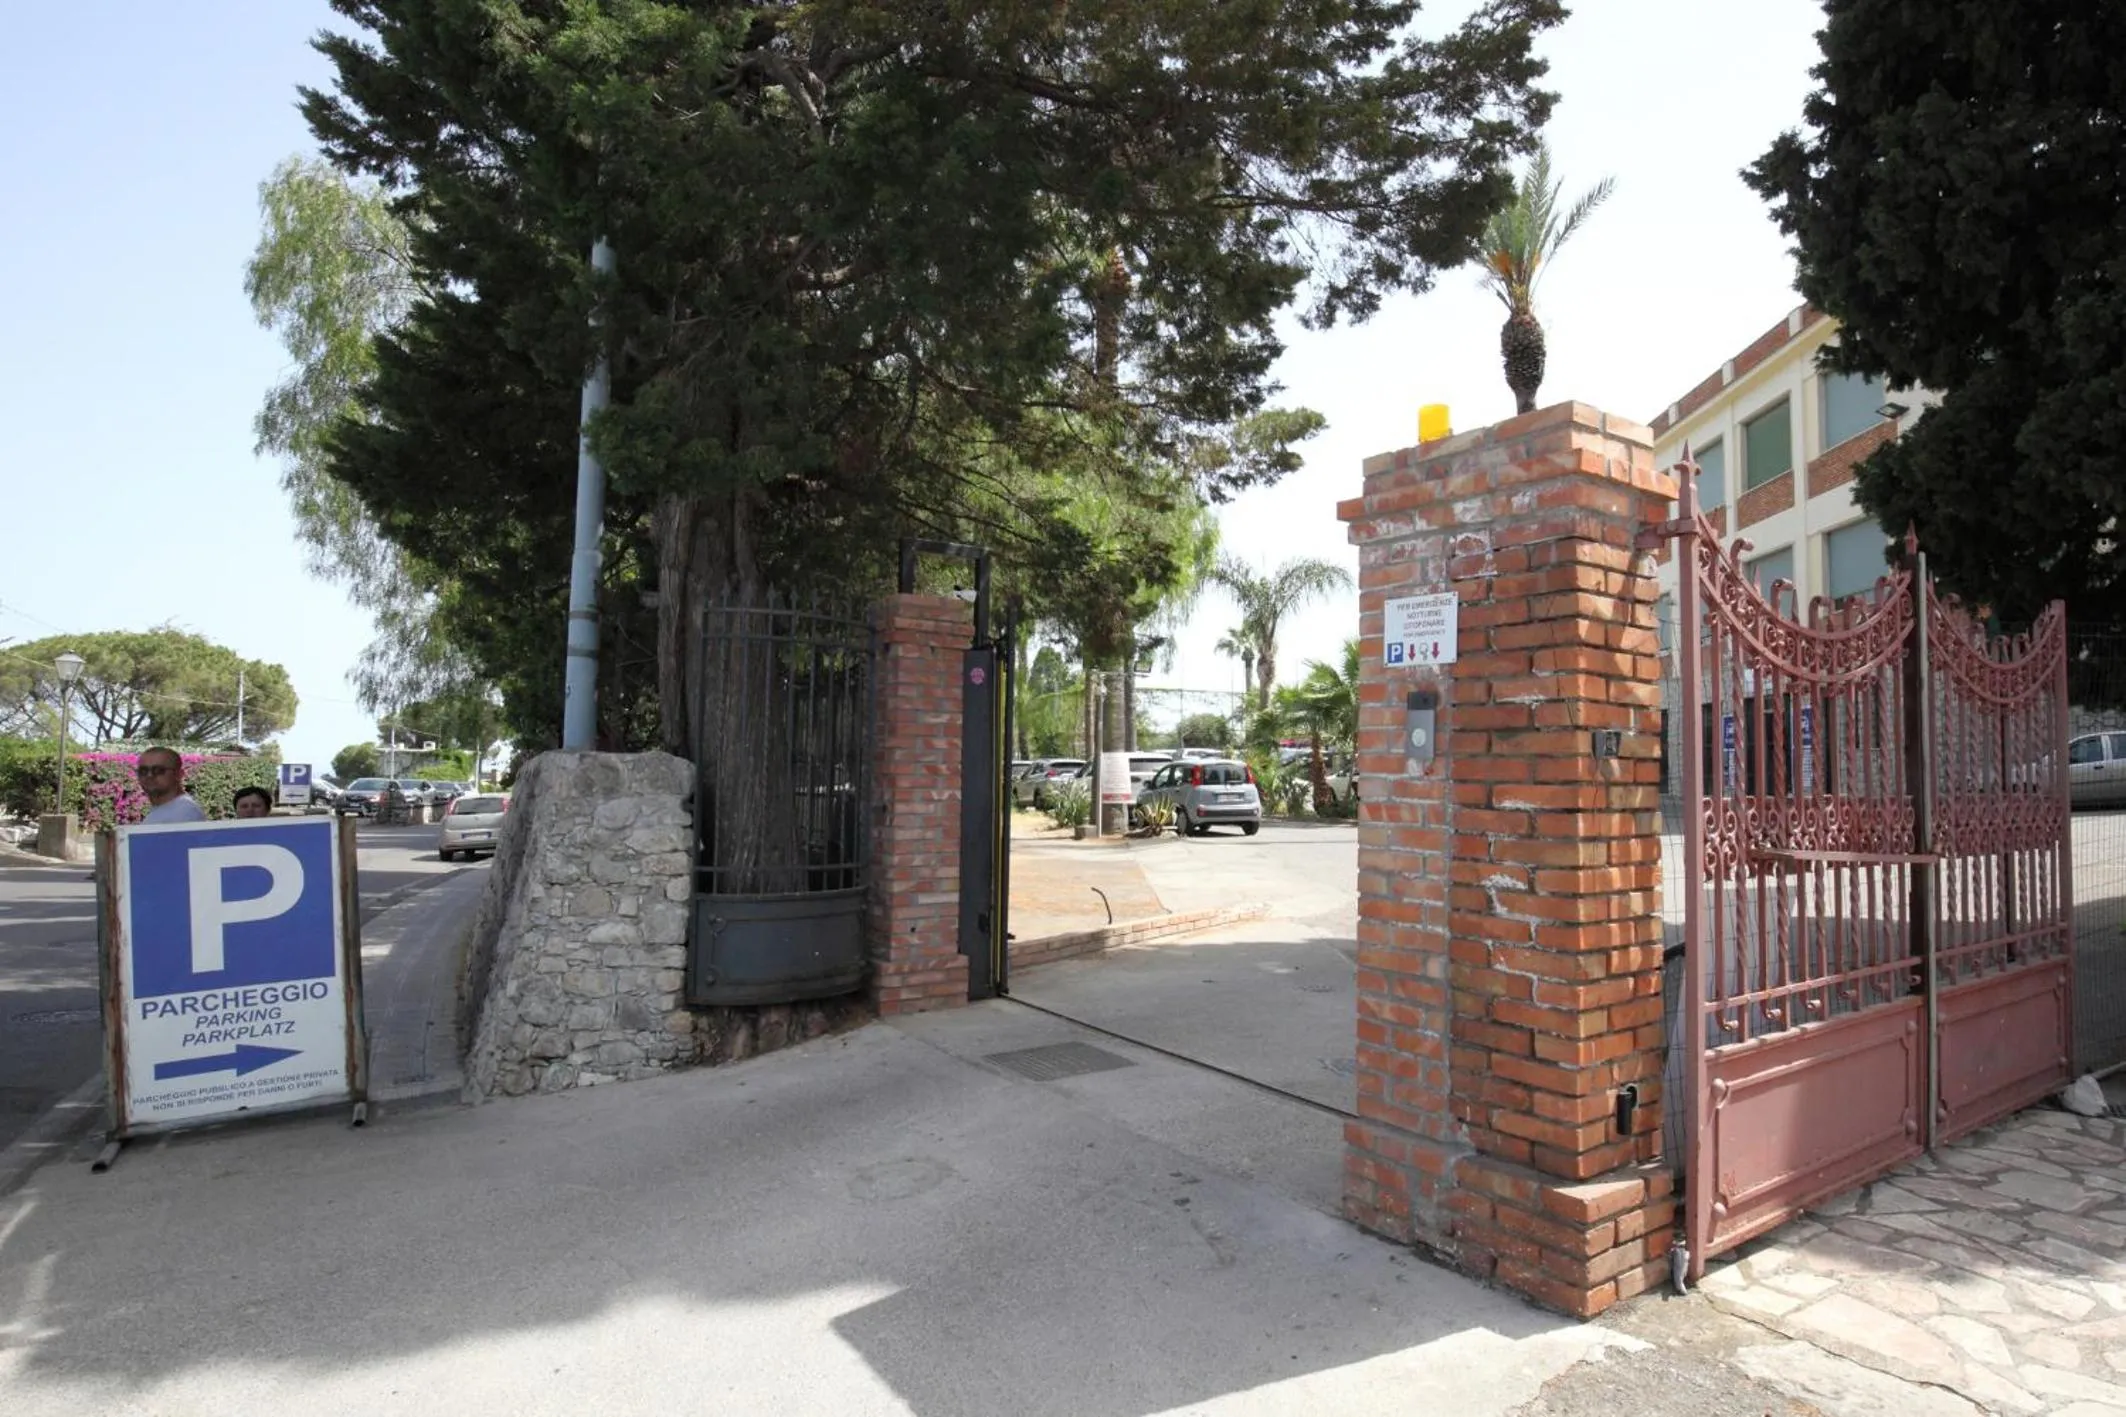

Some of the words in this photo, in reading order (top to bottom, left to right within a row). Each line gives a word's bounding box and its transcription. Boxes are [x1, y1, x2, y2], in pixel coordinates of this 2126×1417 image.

[1391, 645, 1402, 661] P
[290, 764, 306, 783] P
[188, 844, 304, 974] P
[141, 981, 329, 1020] PARCHEGGIO
[195, 1007, 282, 1029] PARKING
[182, 1021, 296, 1047] PARKPLATZ
[133, 1089, 197, 1104] PARCHEGGIO
[256, 1073, 300, 1086] GESTIONE
[303, 1069, 339, 1080] PRIVATA
[153, 1102, 175, 1111] NON
[238, 1089, 256, 1098] PER
[258, 1085, 286, 1095] DANNI
